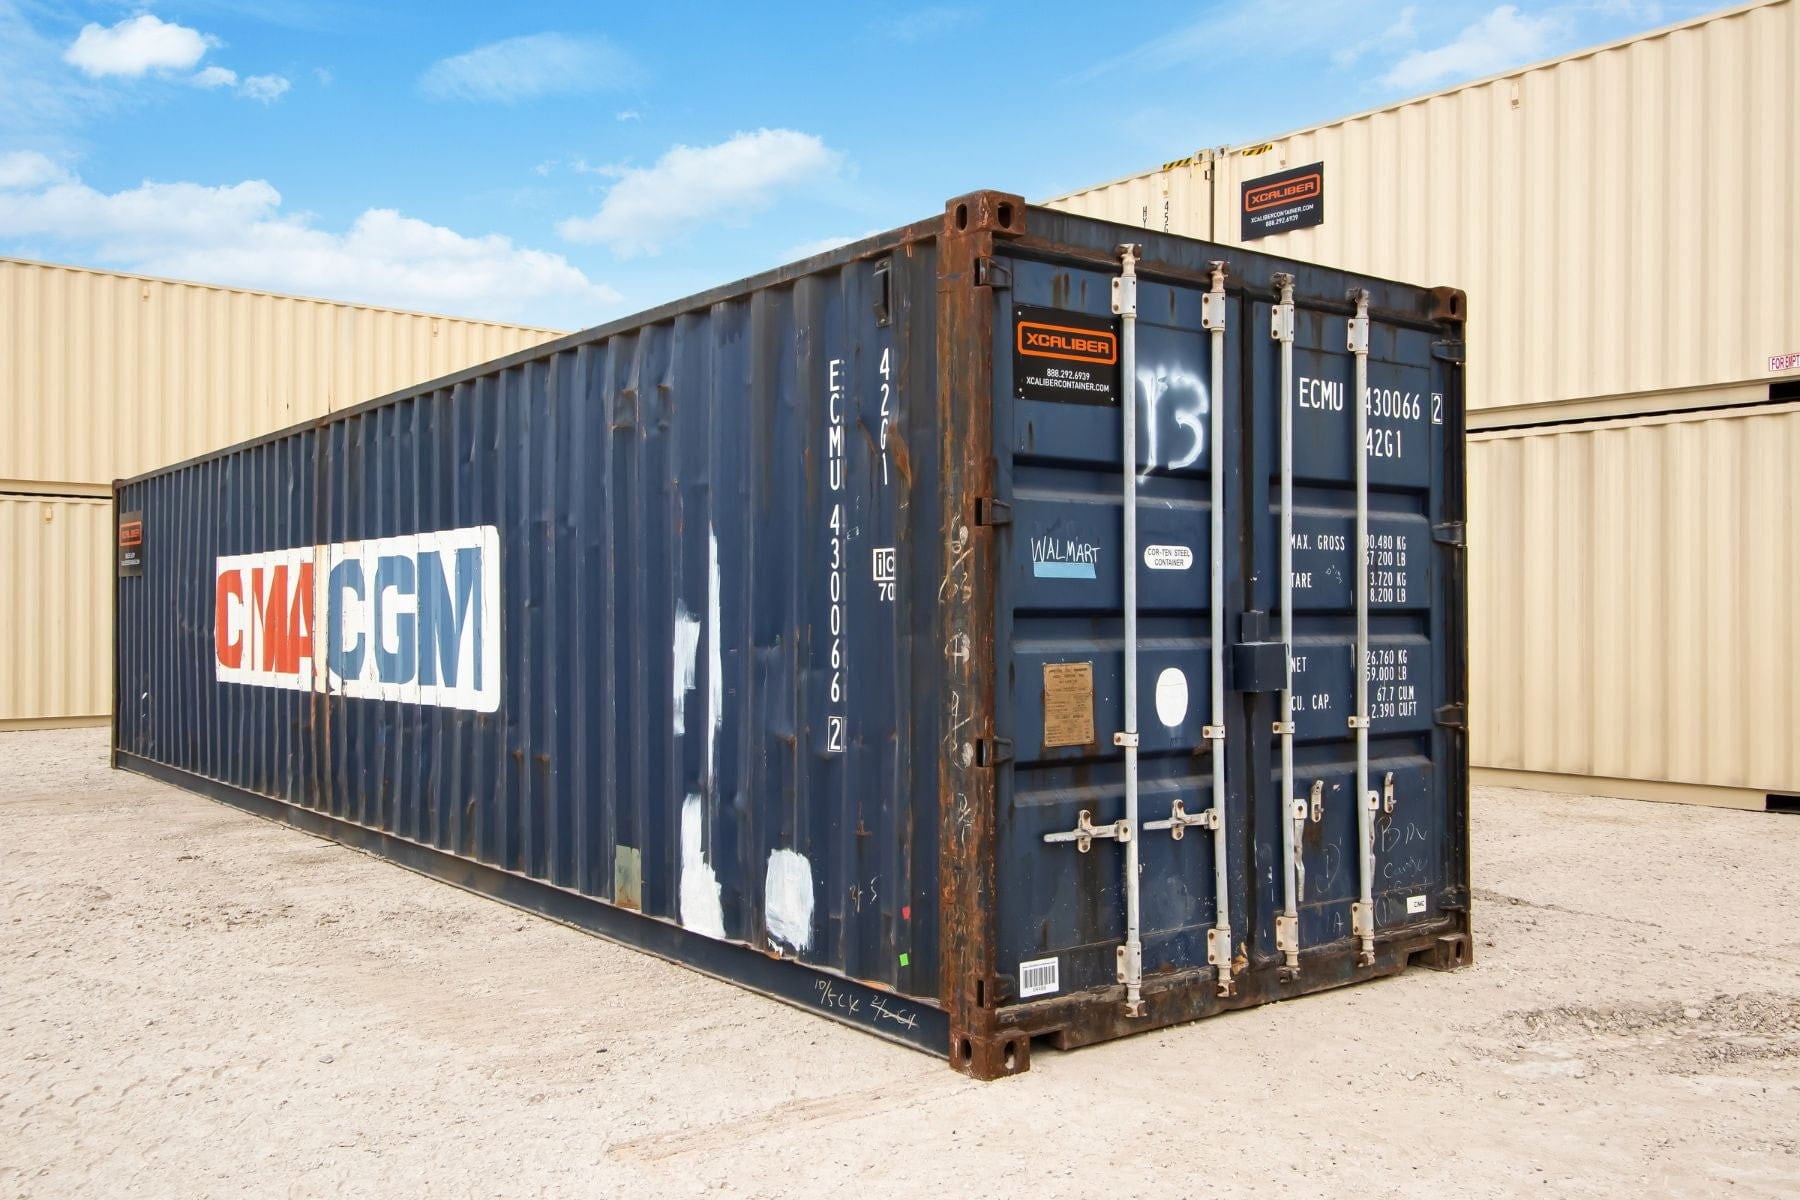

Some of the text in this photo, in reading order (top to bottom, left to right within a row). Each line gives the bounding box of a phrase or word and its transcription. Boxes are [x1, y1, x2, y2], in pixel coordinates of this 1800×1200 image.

[1252, 182, 1314, 204] XCALIBER
[1250, 204, 1314, 223] XCALIBERCONTAINER.COM
[1026, 333, 1109, 354] XCALIBER
[1771, 357, 1784, 369] FOR
[1046, 368, 1091, 381] 888.292.6939
[1026, 376, 1110, 393] XCALIBERCONTAINER.COM
[1300, 377, 1344, 412] ECMU
[1366, 386, 1421, 420] 430066
[829, 359, 841, 491] ECMU
[1366, 428, 1401, 457] 42G1
[1031, 536, 1101, 563] WALMART
[1290, 534, 1312, 550] MAX.
[1317, 535, 1345, 551] GROSS
[1396, 535, 1407, 551] KG
[1147, 548, 1190, 557] COR-TEN STEEL
[1396, 551, 1406, 567] LB
[1154, 558, 1184, 566] CONTAINER
[1290, 572, 1312, 588] TARE
[1370, 571, 1393, 586] 3.720
[1396, 572, 1407, 586] KG
[829, 503, 841, 702] 430066
[1370, 588, 1406, 603] 8.200 LB
[216, 546, 483, 691] CMA CGM
[1290, 649, 1407, 673] NET 26.760 KG
[1398, 665, 1407, 681] LB
[1291, 695, 1305, 711] CU.
[1312, 693, 1331, 710] CAP.
[1377, 686, 1394, 702] 67.7
[1371, 703, 1395, 719] 2.390
